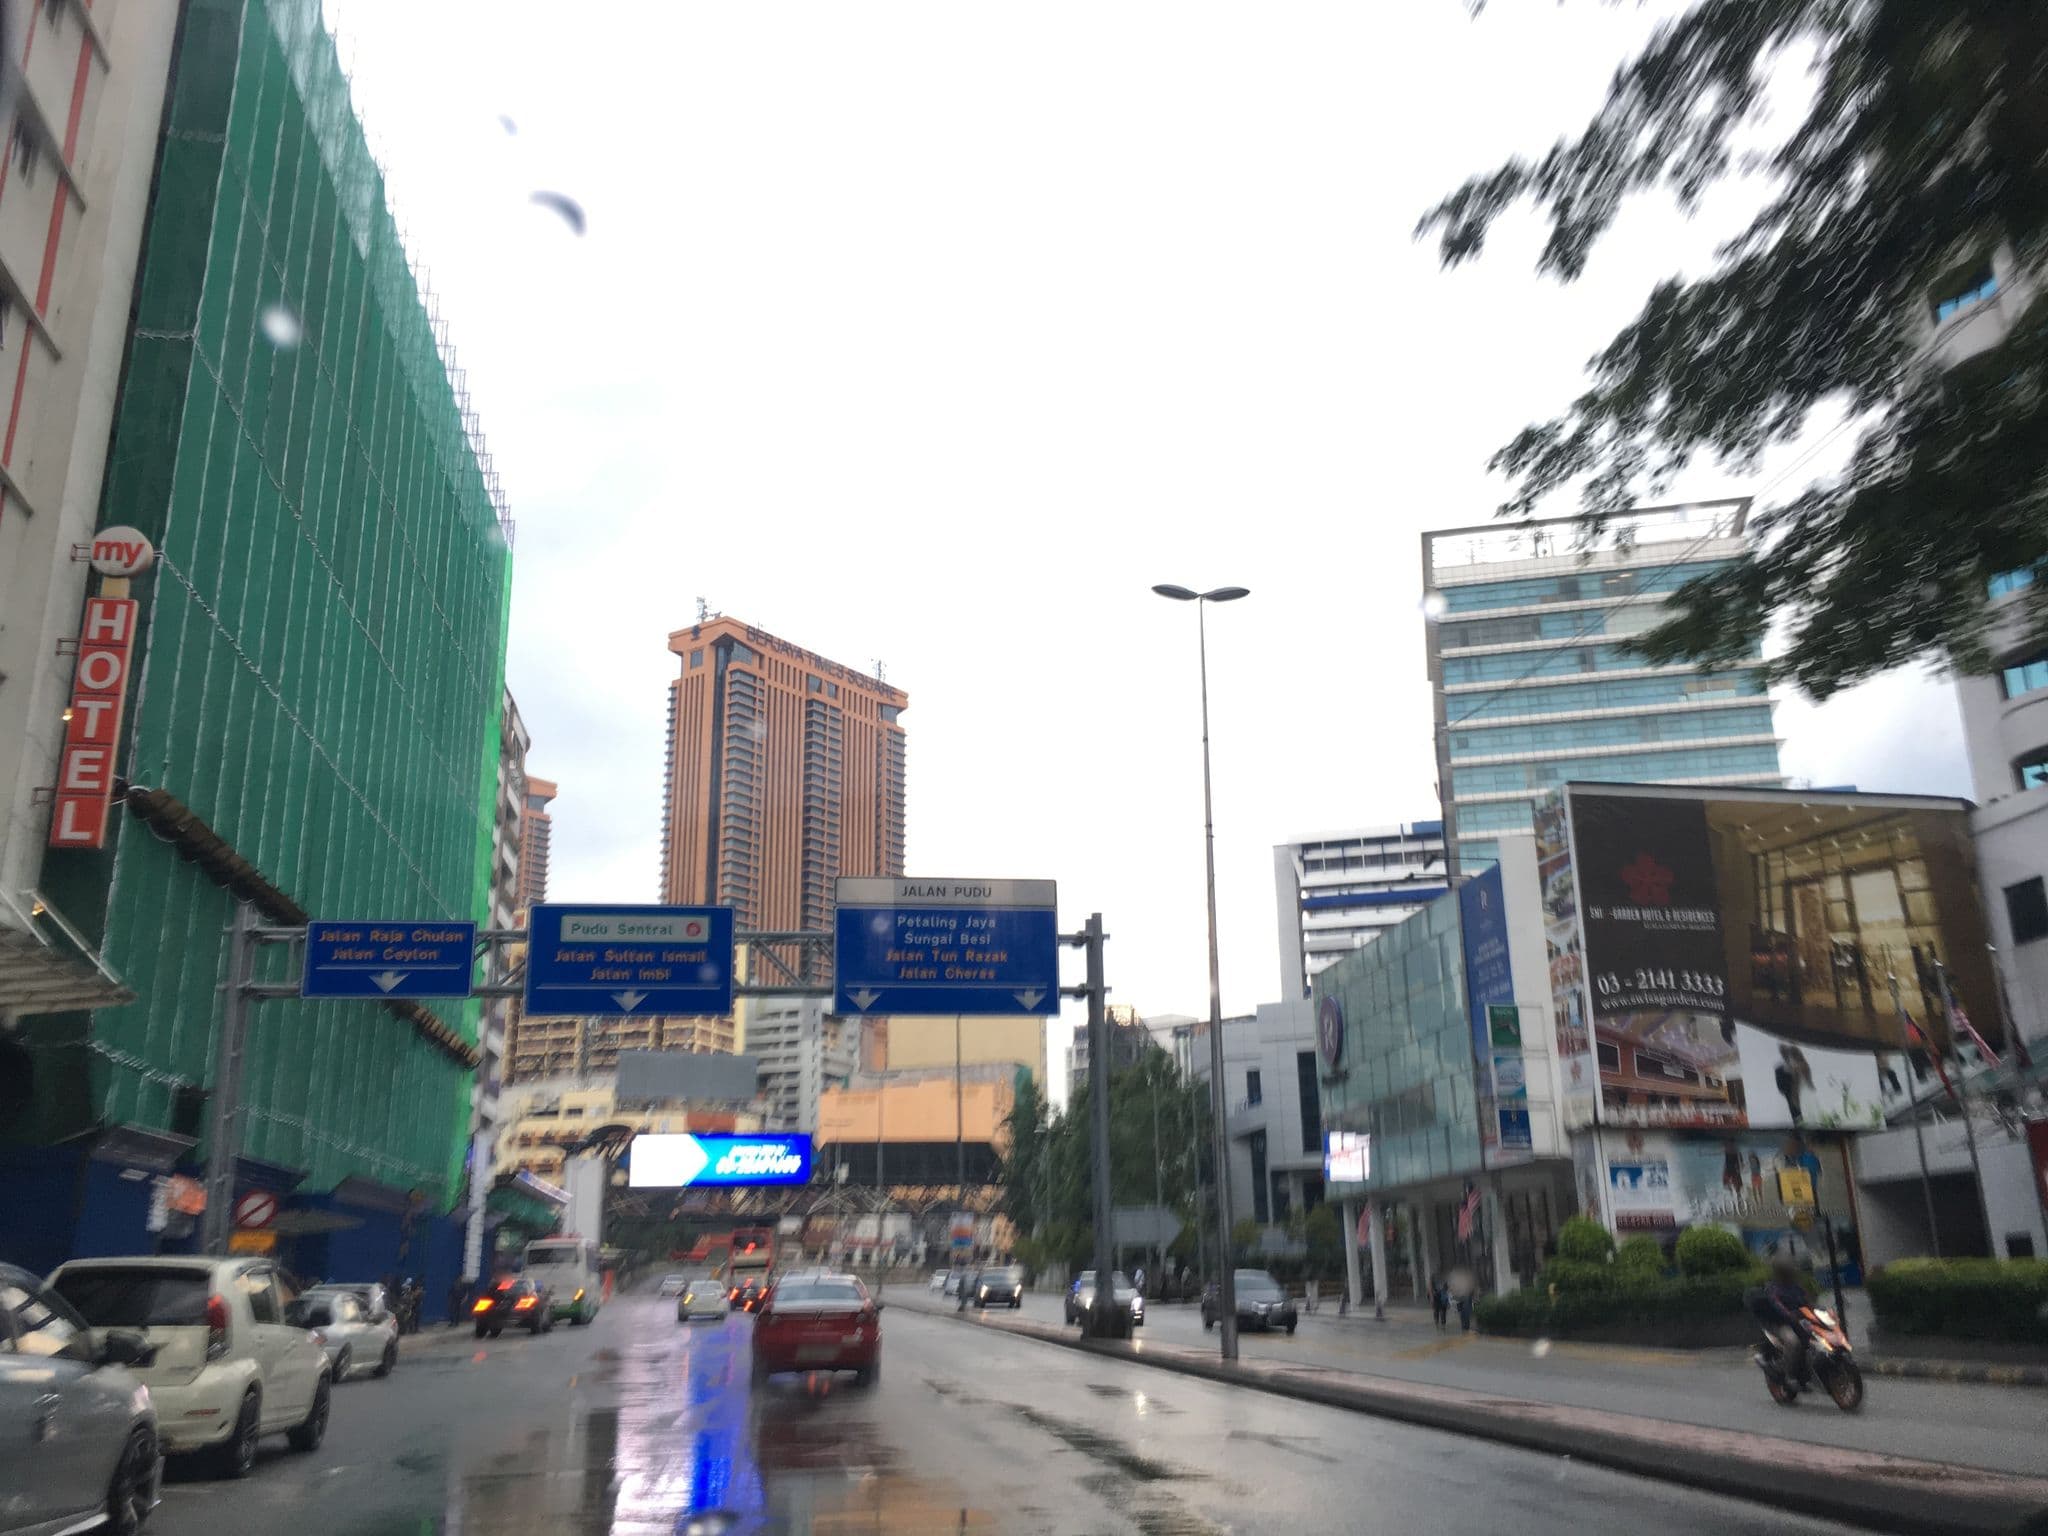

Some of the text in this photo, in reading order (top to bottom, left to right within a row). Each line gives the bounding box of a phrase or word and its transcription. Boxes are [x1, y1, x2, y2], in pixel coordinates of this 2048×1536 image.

[92, 539, 145, 568] my
[746, 625, 804, 663] BERJAYA
[804, 650, 845, 680] TIMES
[58, 602, 128, 841] HOTEL
[902, 885, 992, 898] JALAN PUDU
[570, 923, 673, 936] Pudu Sentral
[896, 916, 996, 929] Petaling Jaya
[318, 928, 464, 944] Jalan Raja Chulan
[904, 932, 991, 946] Sungai Besi
[331, 948, 439, 963] Jalan Ceylon
[554, 950, 708, 963] Jalan Sultan Ismail
[886, 949, 1008, 962] Jalan Tun Razak
[590, 967, 672, 981] Jalan Imbi
[899, 967, 995, 980] Jalan Cheras
[1597, 973, 1620, 995] 03
[1635, 968, 1677, 990] 2141
[1680, 970, 1725, 996] 3333
